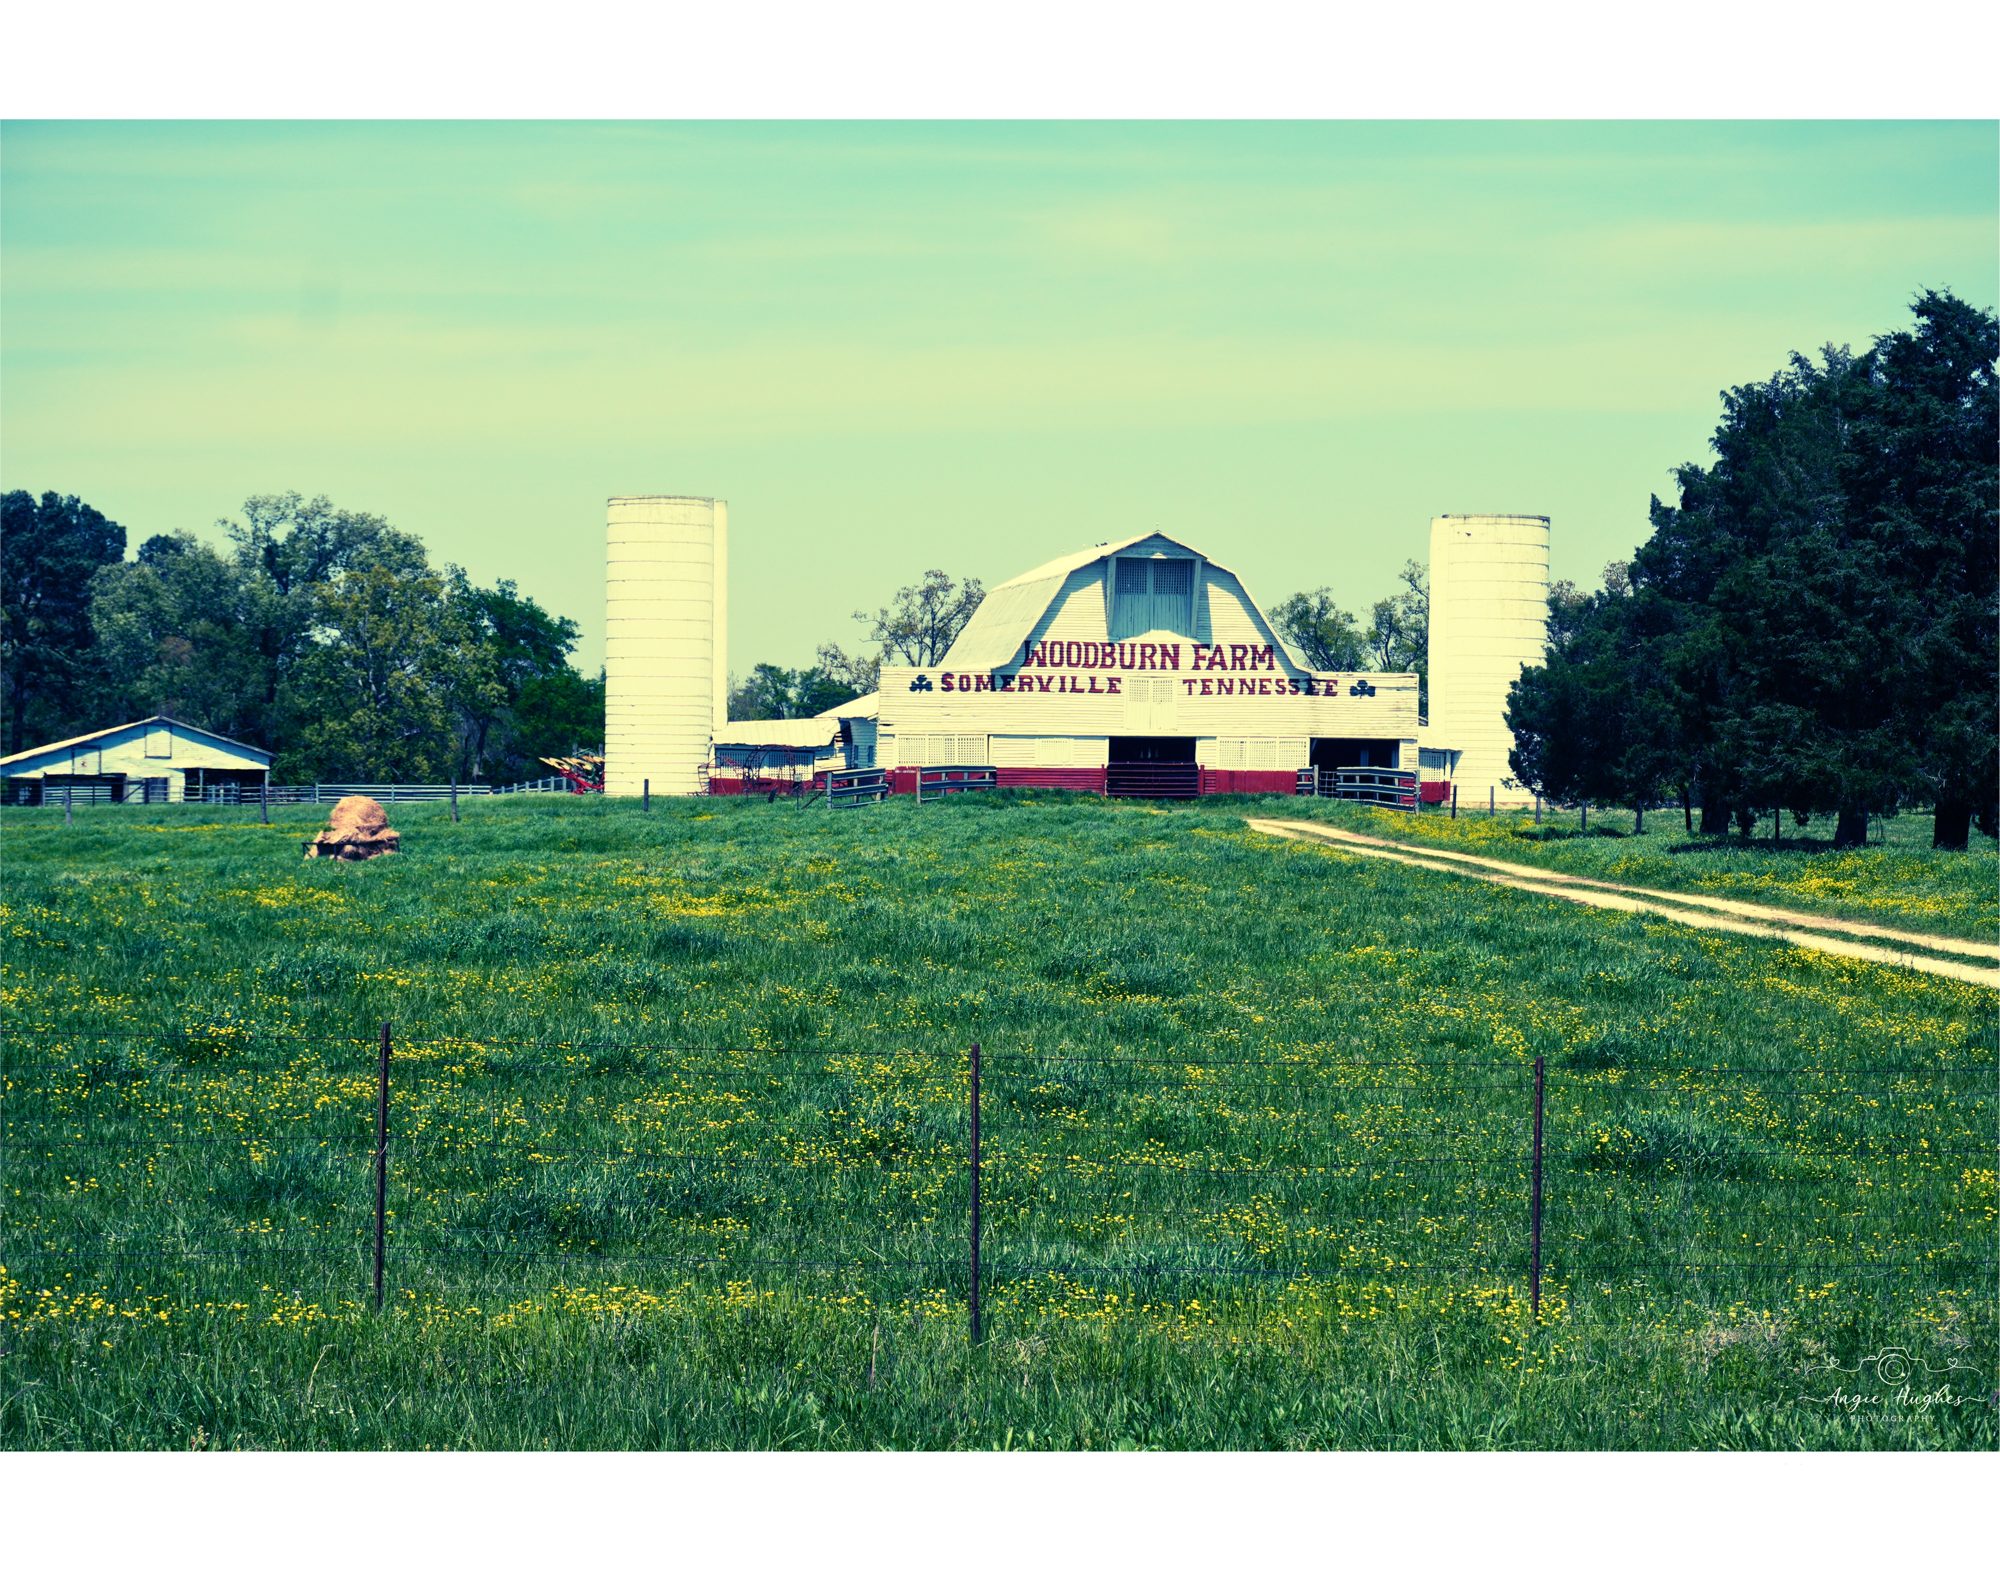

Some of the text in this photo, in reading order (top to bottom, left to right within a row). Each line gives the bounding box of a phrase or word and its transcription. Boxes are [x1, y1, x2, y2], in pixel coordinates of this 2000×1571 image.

[1023, 639, 1275, 670] WOODBURN FARM
[940, 673, 1339, 697] SOMERVILLE TENNESSEE
